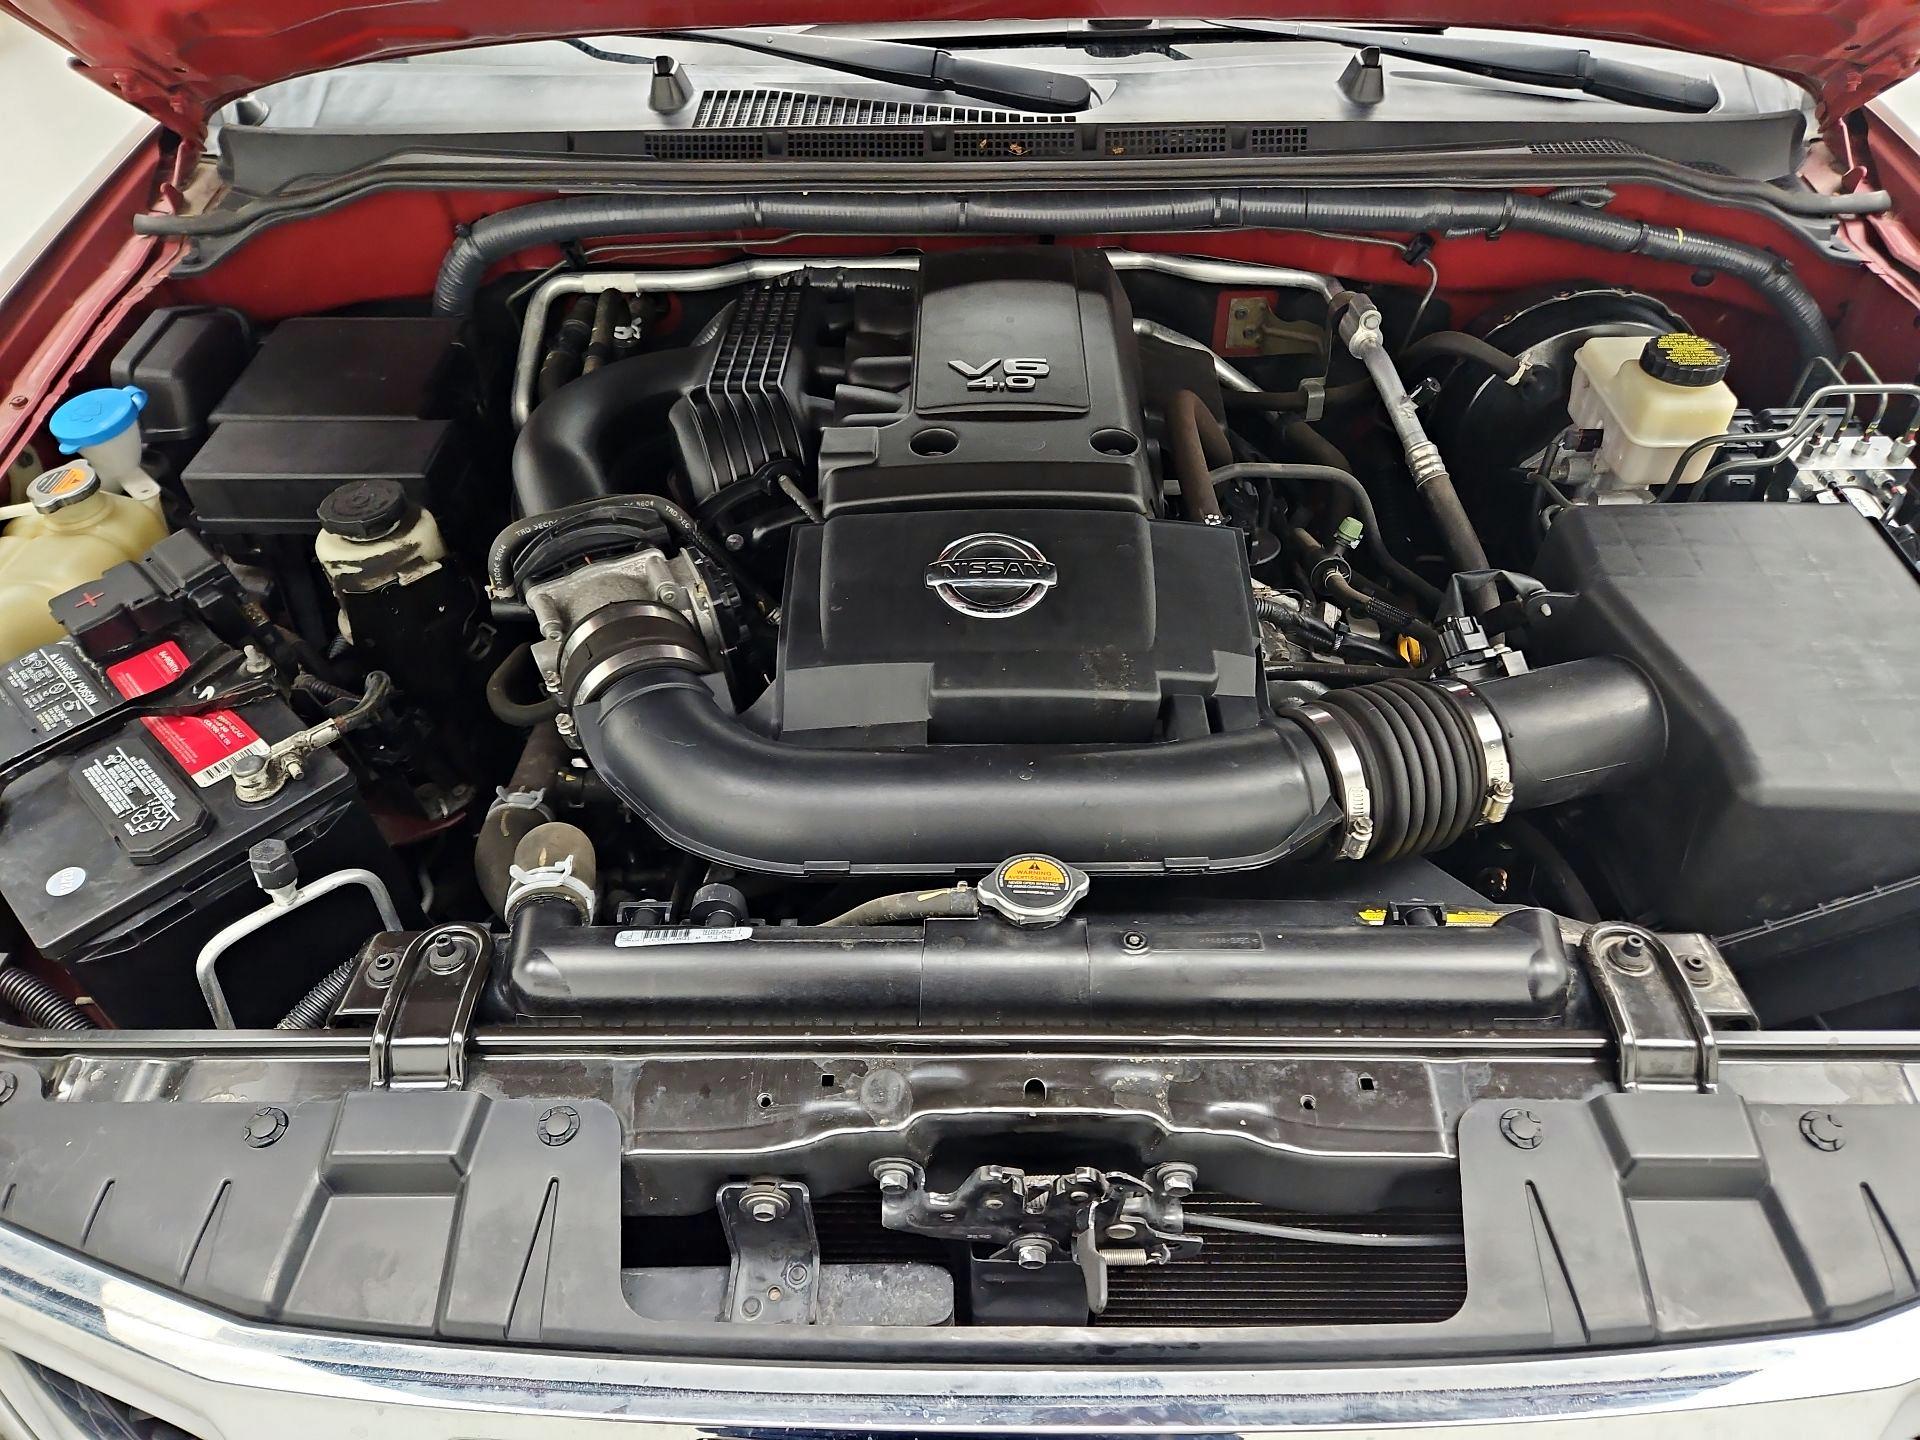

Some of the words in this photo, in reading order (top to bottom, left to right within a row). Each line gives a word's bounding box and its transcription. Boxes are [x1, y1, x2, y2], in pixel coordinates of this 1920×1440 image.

[949, 358, 1051, 377] V6
[967, 375, 1037, 391] 4.0
[665, 505, 678, 517] TRD
[515, 527, 531, 536] TRD
[941, 562, 1044, 575] NISSAN
[54, 657, 77, 681] DANGER
[75, 682, 99, 705] POISON
